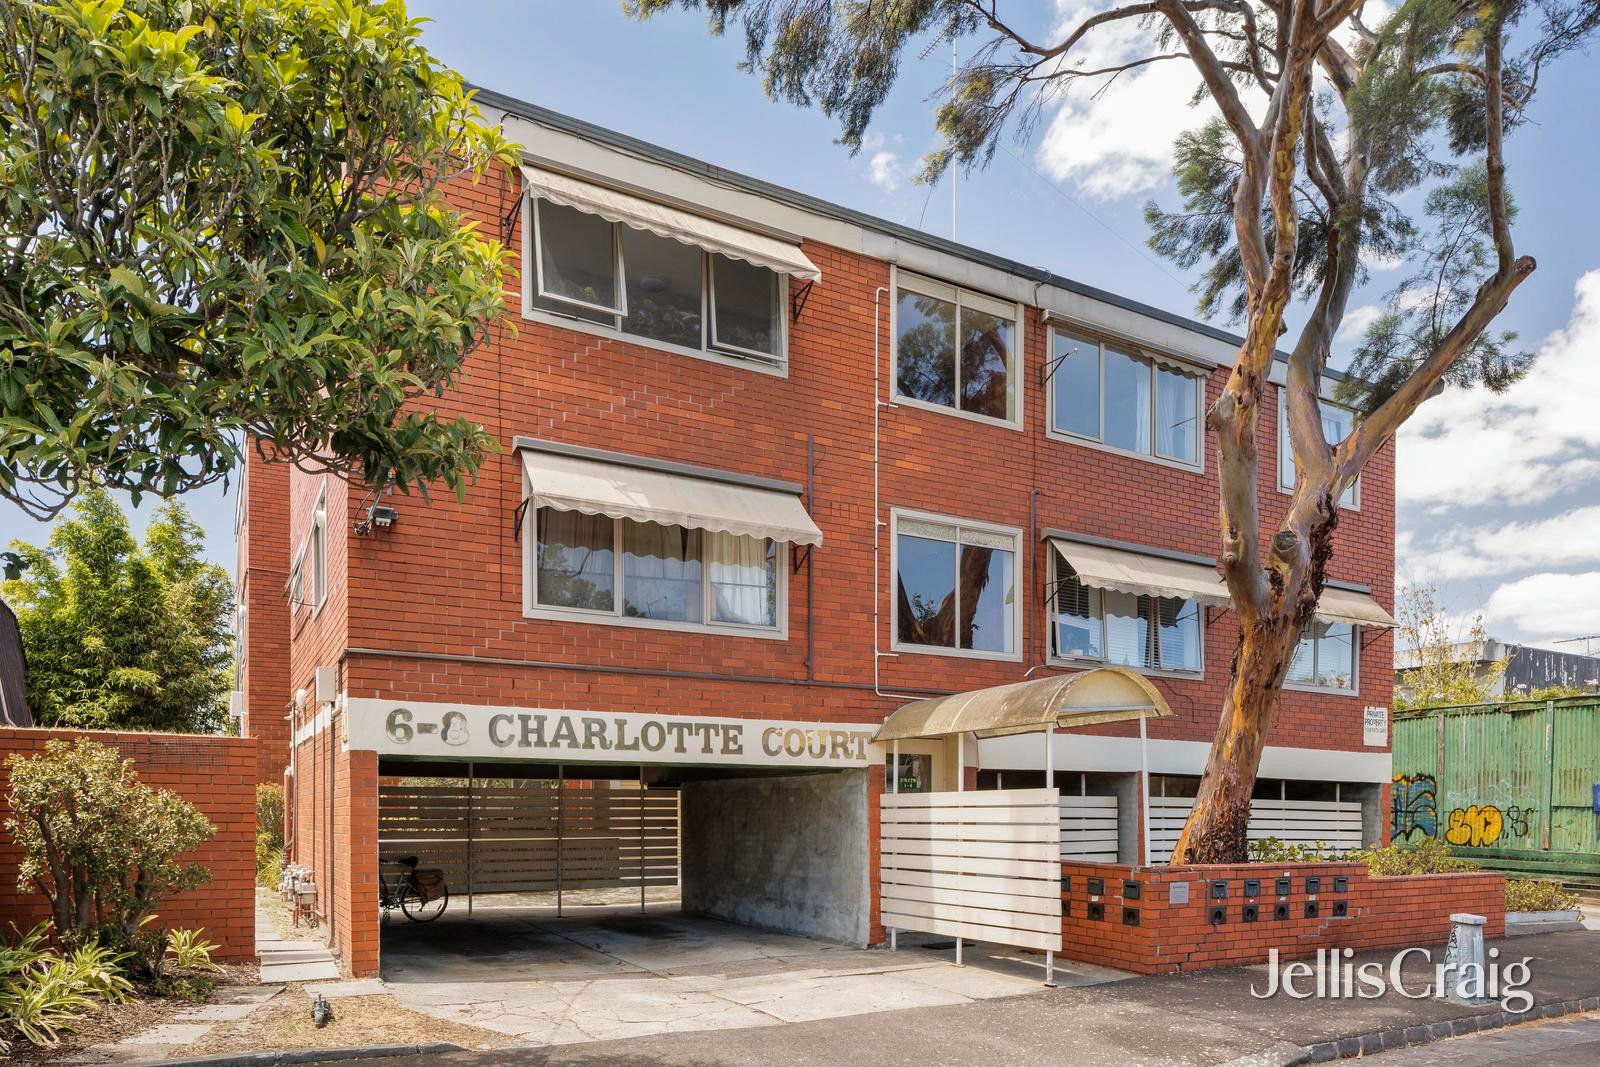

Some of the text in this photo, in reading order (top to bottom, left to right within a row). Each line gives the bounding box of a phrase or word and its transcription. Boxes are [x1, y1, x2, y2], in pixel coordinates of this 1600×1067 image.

[386, 708, 873, 760] 6-8 CHARLOTTE COURT
